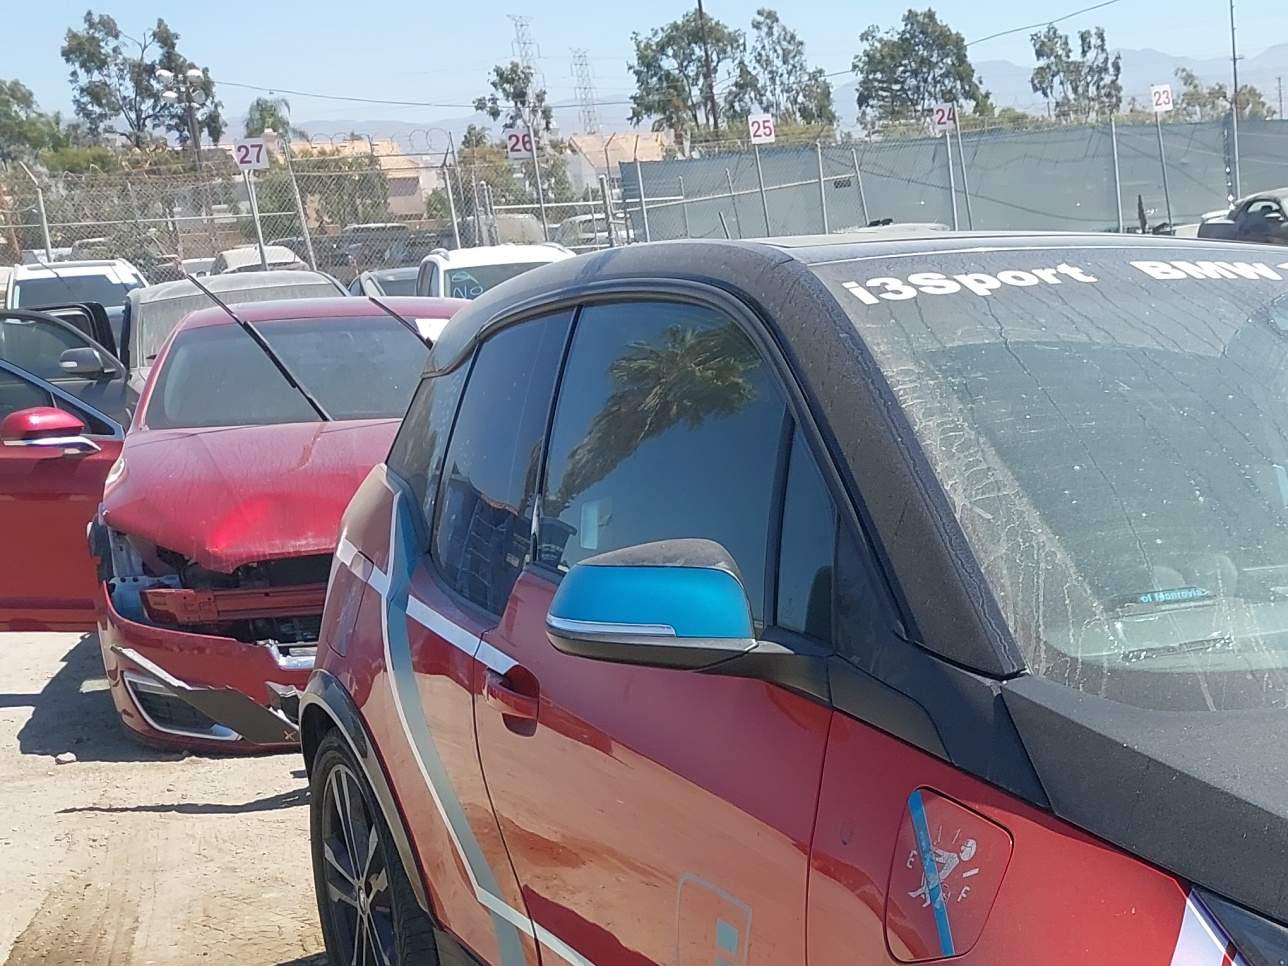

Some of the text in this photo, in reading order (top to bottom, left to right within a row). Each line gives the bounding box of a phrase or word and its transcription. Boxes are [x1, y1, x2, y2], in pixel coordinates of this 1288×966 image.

[1153, 90, 1171, 106] 23
[935, 107, 957, 126] 24
[751, 119, 773, 138] 25
[507, 133, 533, 153] 26
[237, 143, 263, 165] 27
[841, 262, 1099, 305] i3Sport
[1130, 260, 1284, 281] BMW
